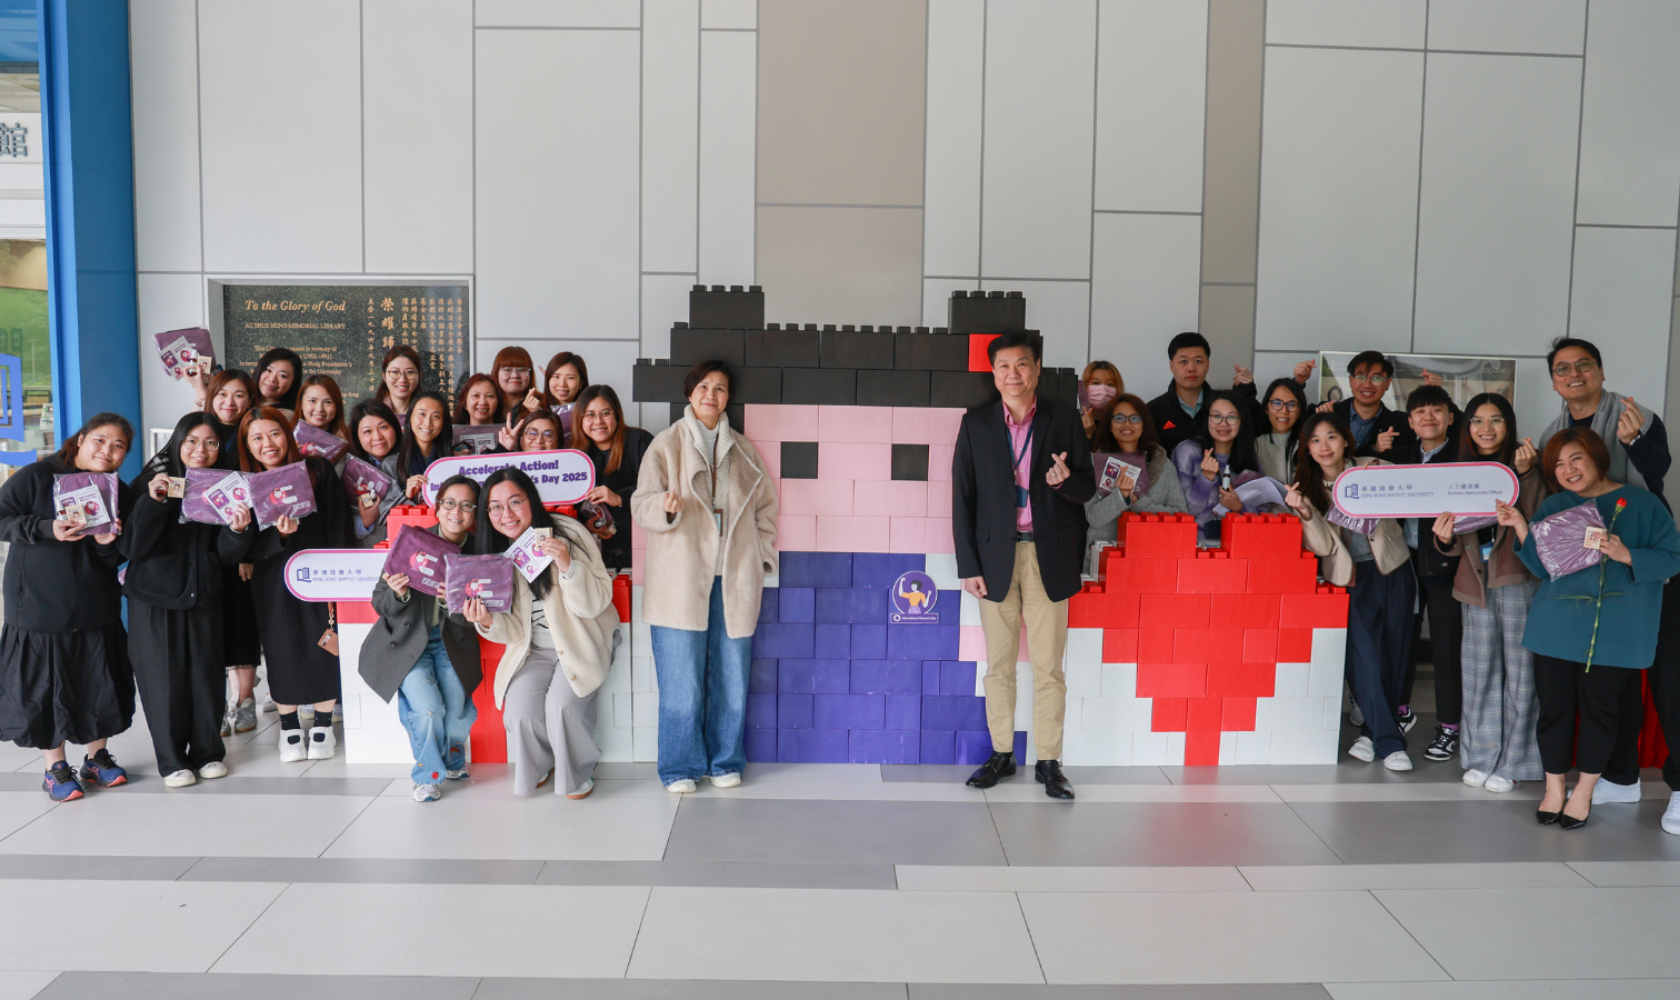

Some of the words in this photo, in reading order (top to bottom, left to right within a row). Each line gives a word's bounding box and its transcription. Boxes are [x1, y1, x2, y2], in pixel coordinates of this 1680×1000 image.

[0, 122, 28, 158] 館
[245, 301, 259, 310] To
[262, 300, 278, 310] the
[280, 300, 310, 313] Glory
[312, 300, 324, 313] of
[325, 300, 347, 310] God
[520, 460, 558, 471] Action!
[542, 474, 560, 484] Day
[562, 472, 588, 482] 2025
